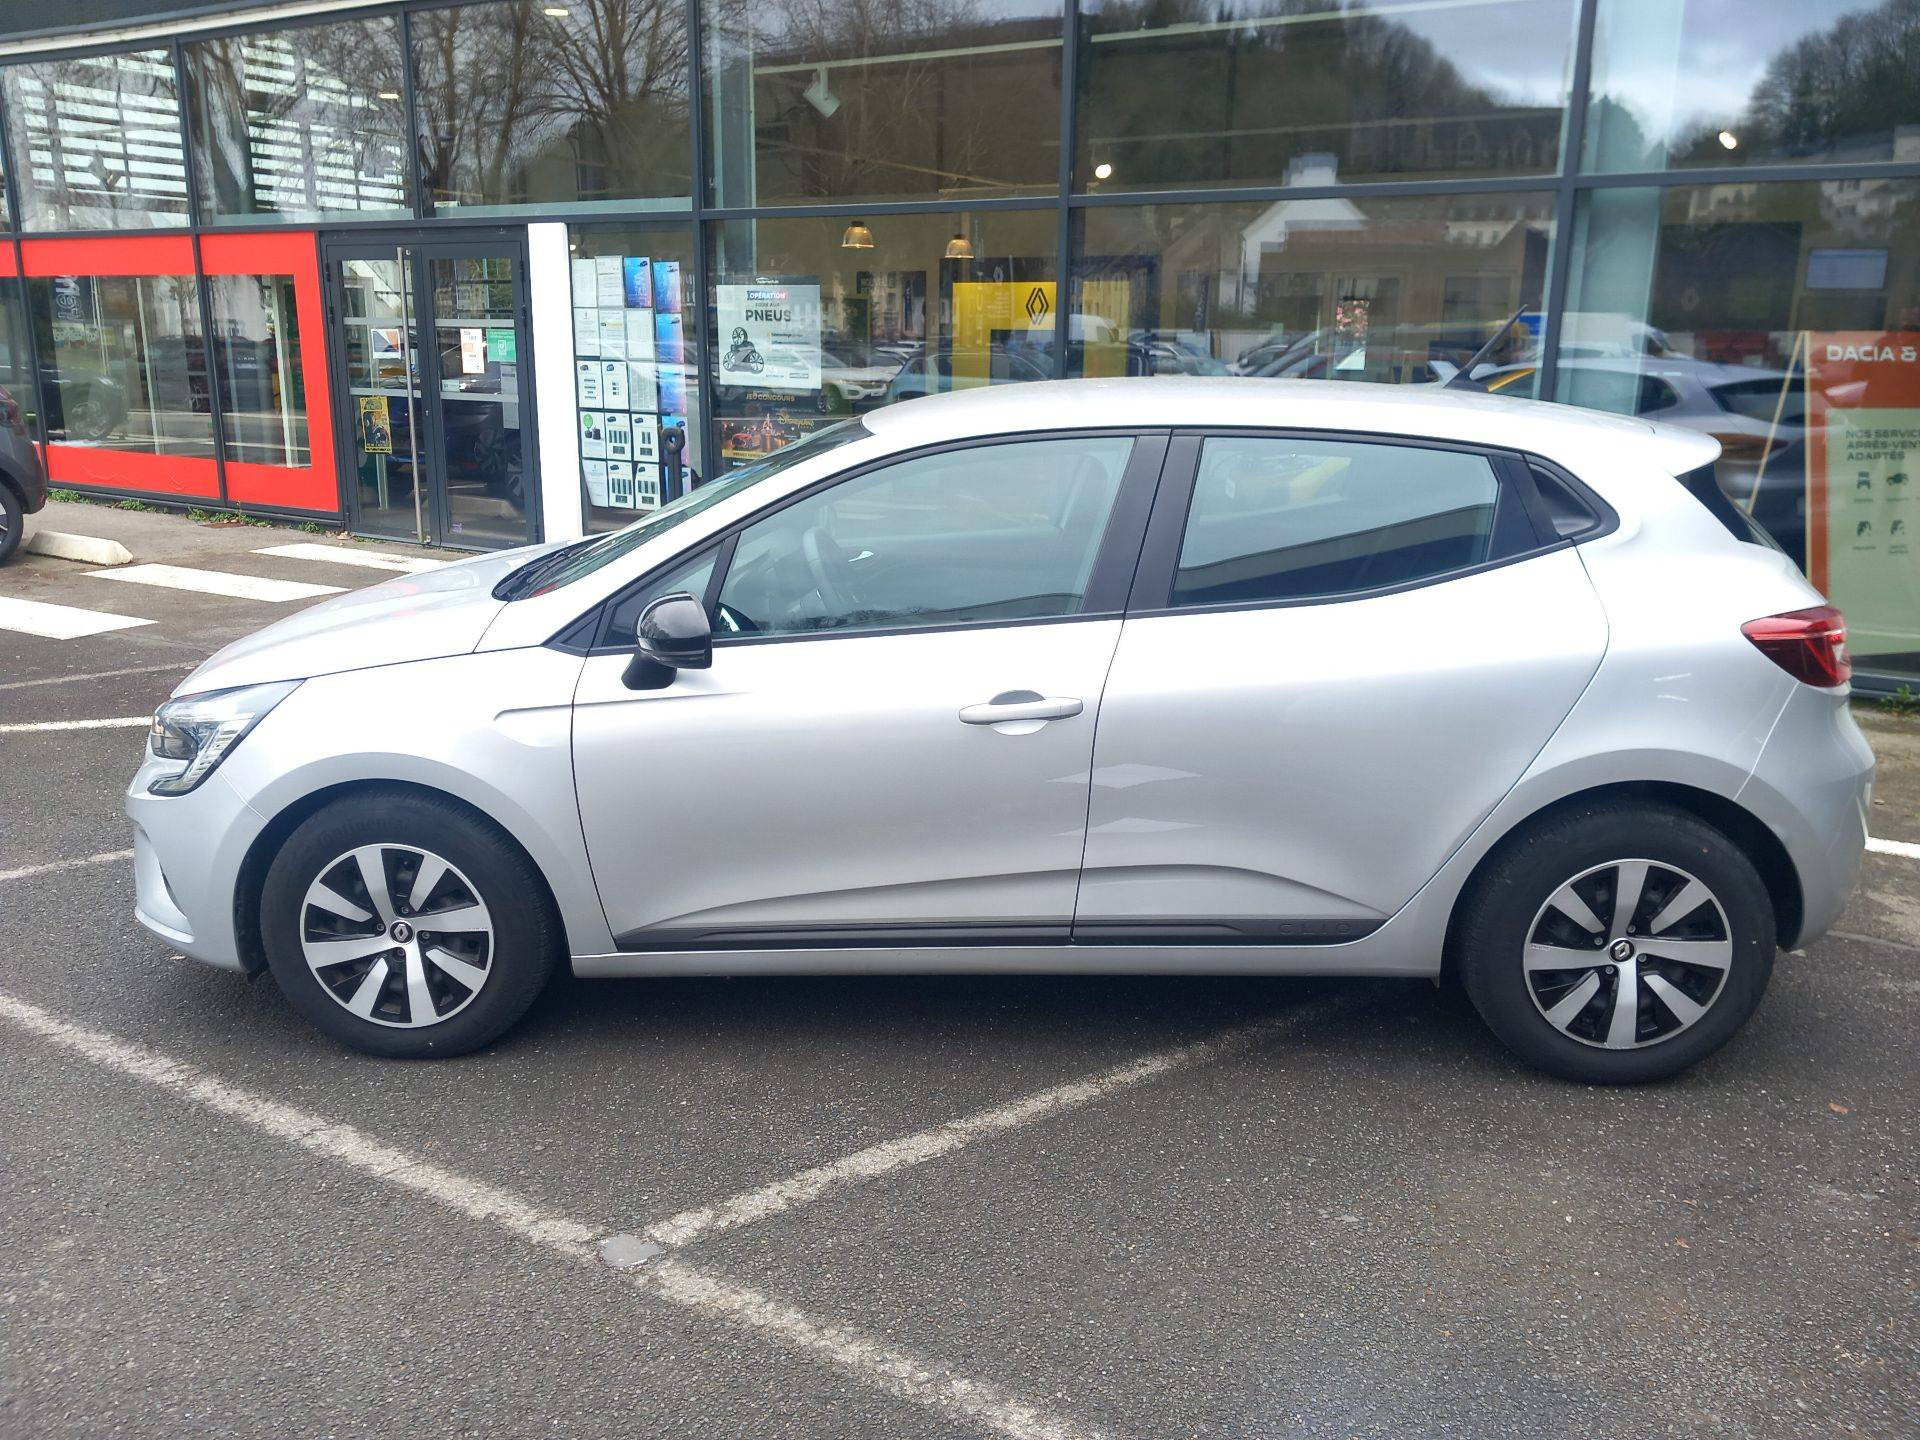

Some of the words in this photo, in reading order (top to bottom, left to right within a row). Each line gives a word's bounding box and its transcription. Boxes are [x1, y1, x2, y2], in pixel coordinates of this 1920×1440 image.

[749, 291, 786, 300] OPÉRATION
[745, 309, 792, 322] PNEUS
[1826, 345, 1895, 362] DACIA
[1900, 347, 1918, 362] &
[1845, 429, 1872, 439] NOS
[1874, 429, 1920, 439] SERVIC
